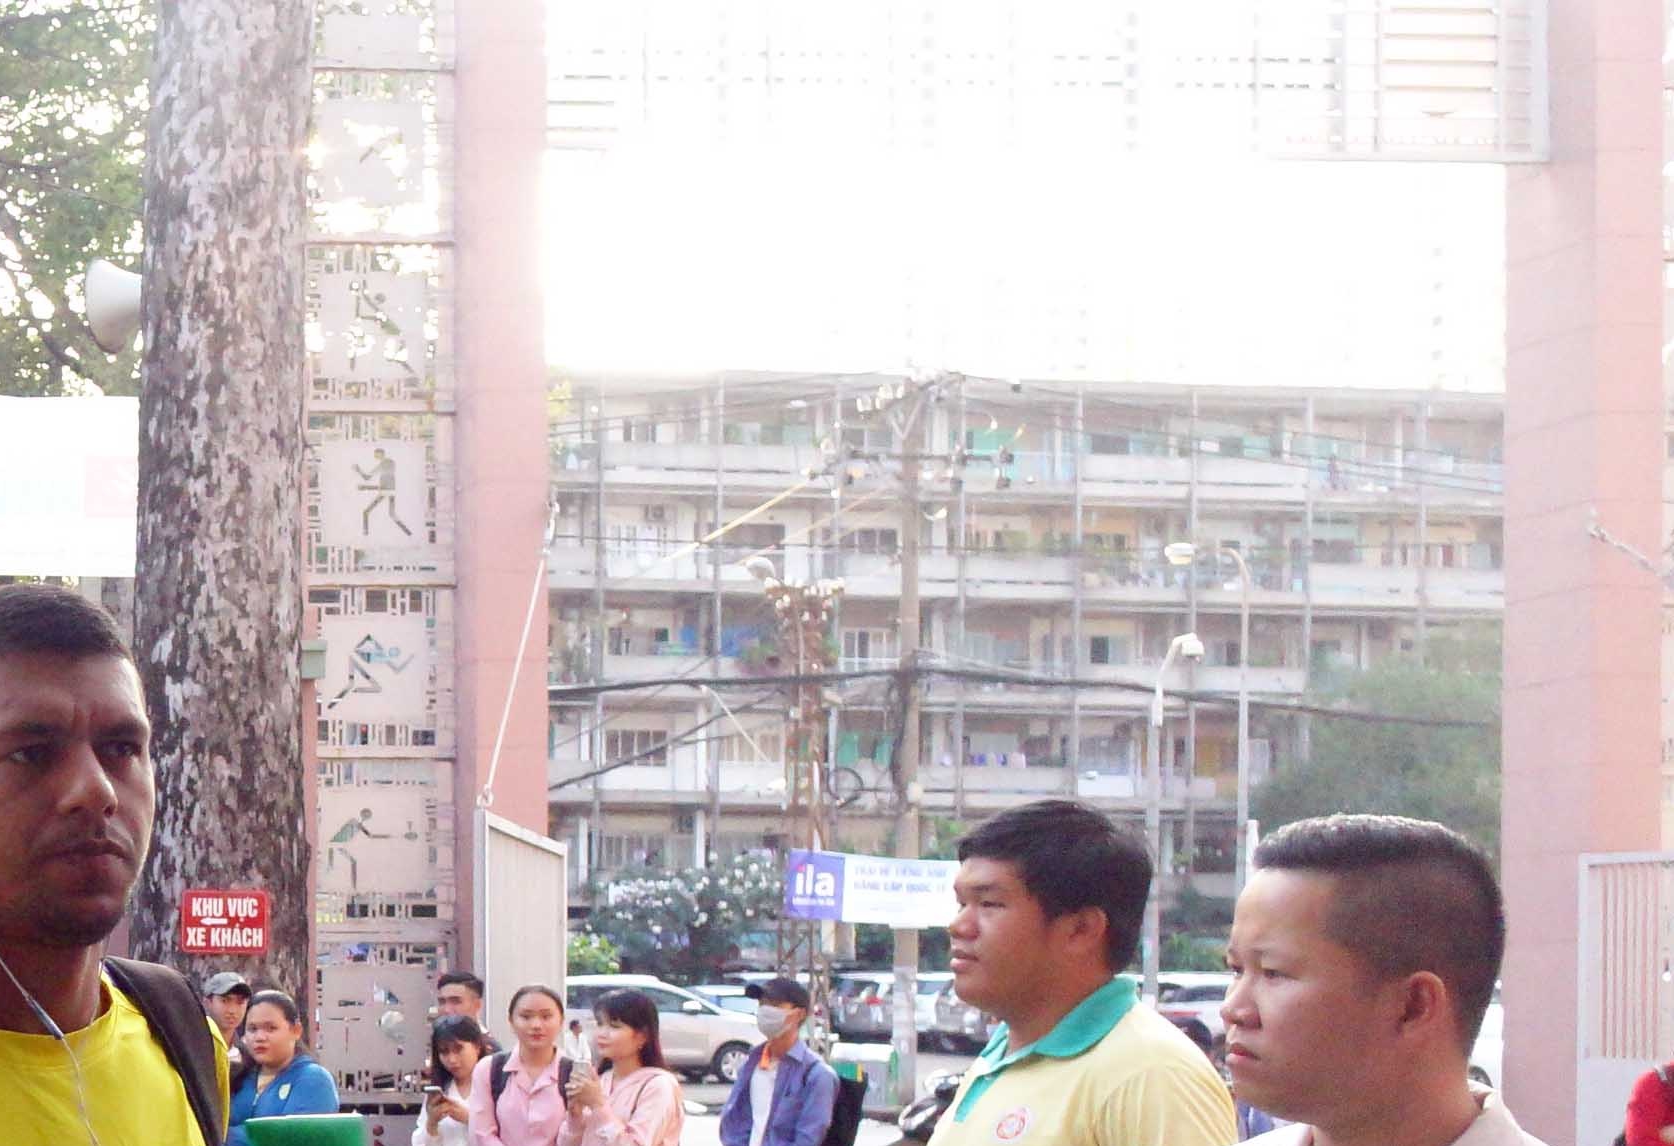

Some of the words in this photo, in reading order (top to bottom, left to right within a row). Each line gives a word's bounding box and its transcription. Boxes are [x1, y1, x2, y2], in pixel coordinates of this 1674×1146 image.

[795, 863, 835, 896] ila
[191, 897, 224, 917] KHU
[227, 896, 258, 922] VỰC
[186, 927, 206, 947] XE
[210, 923, 263, 947] KHÁCH
